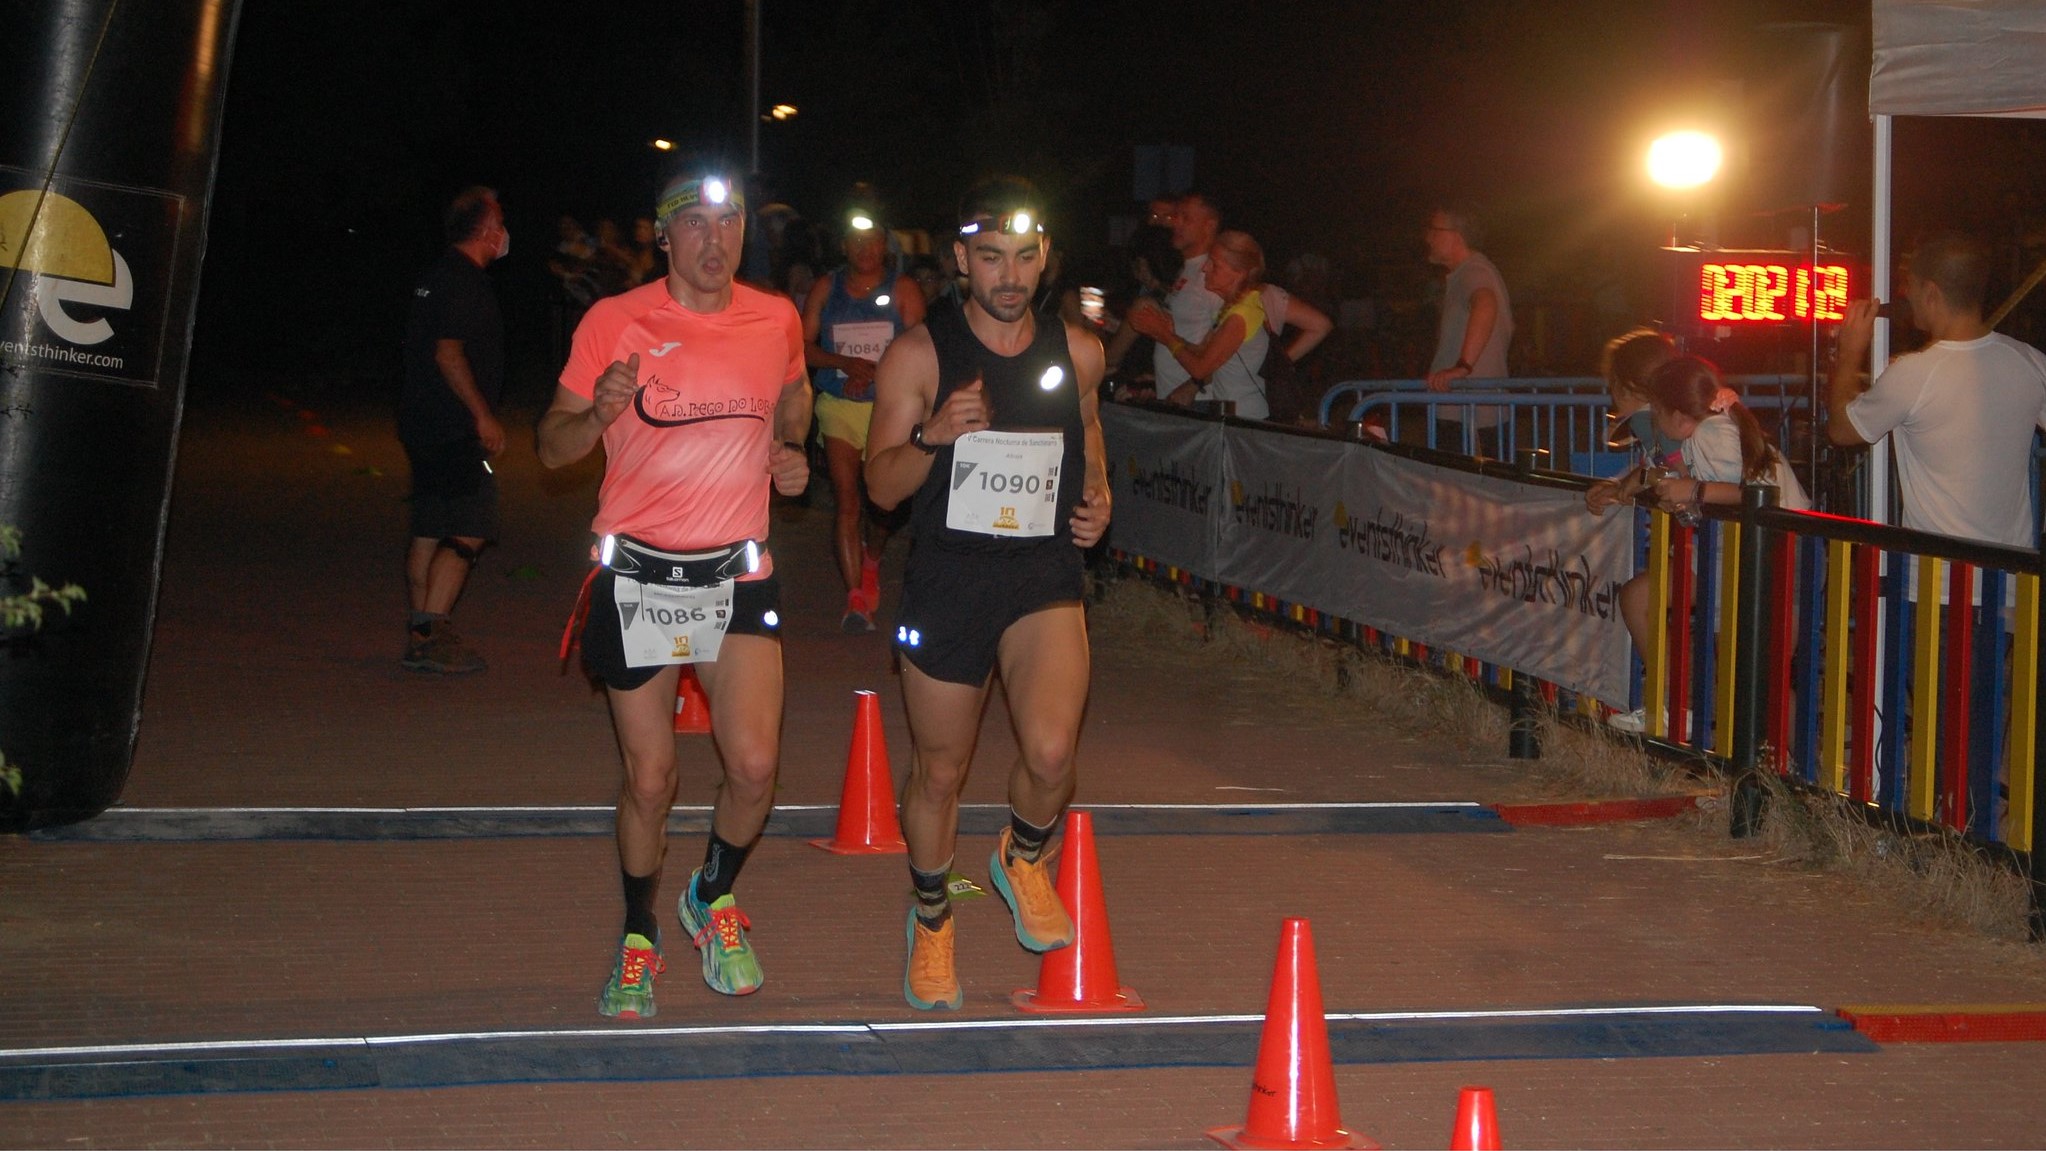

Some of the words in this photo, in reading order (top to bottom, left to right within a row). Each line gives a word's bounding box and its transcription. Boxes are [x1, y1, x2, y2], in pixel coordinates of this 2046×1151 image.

[848, 343, 880, 354] 1084
[980, 472, 1041, 494] 1090
[1339, 505, 1447, 578] eventsthinker
[645, 607, 706, 625] 1086
